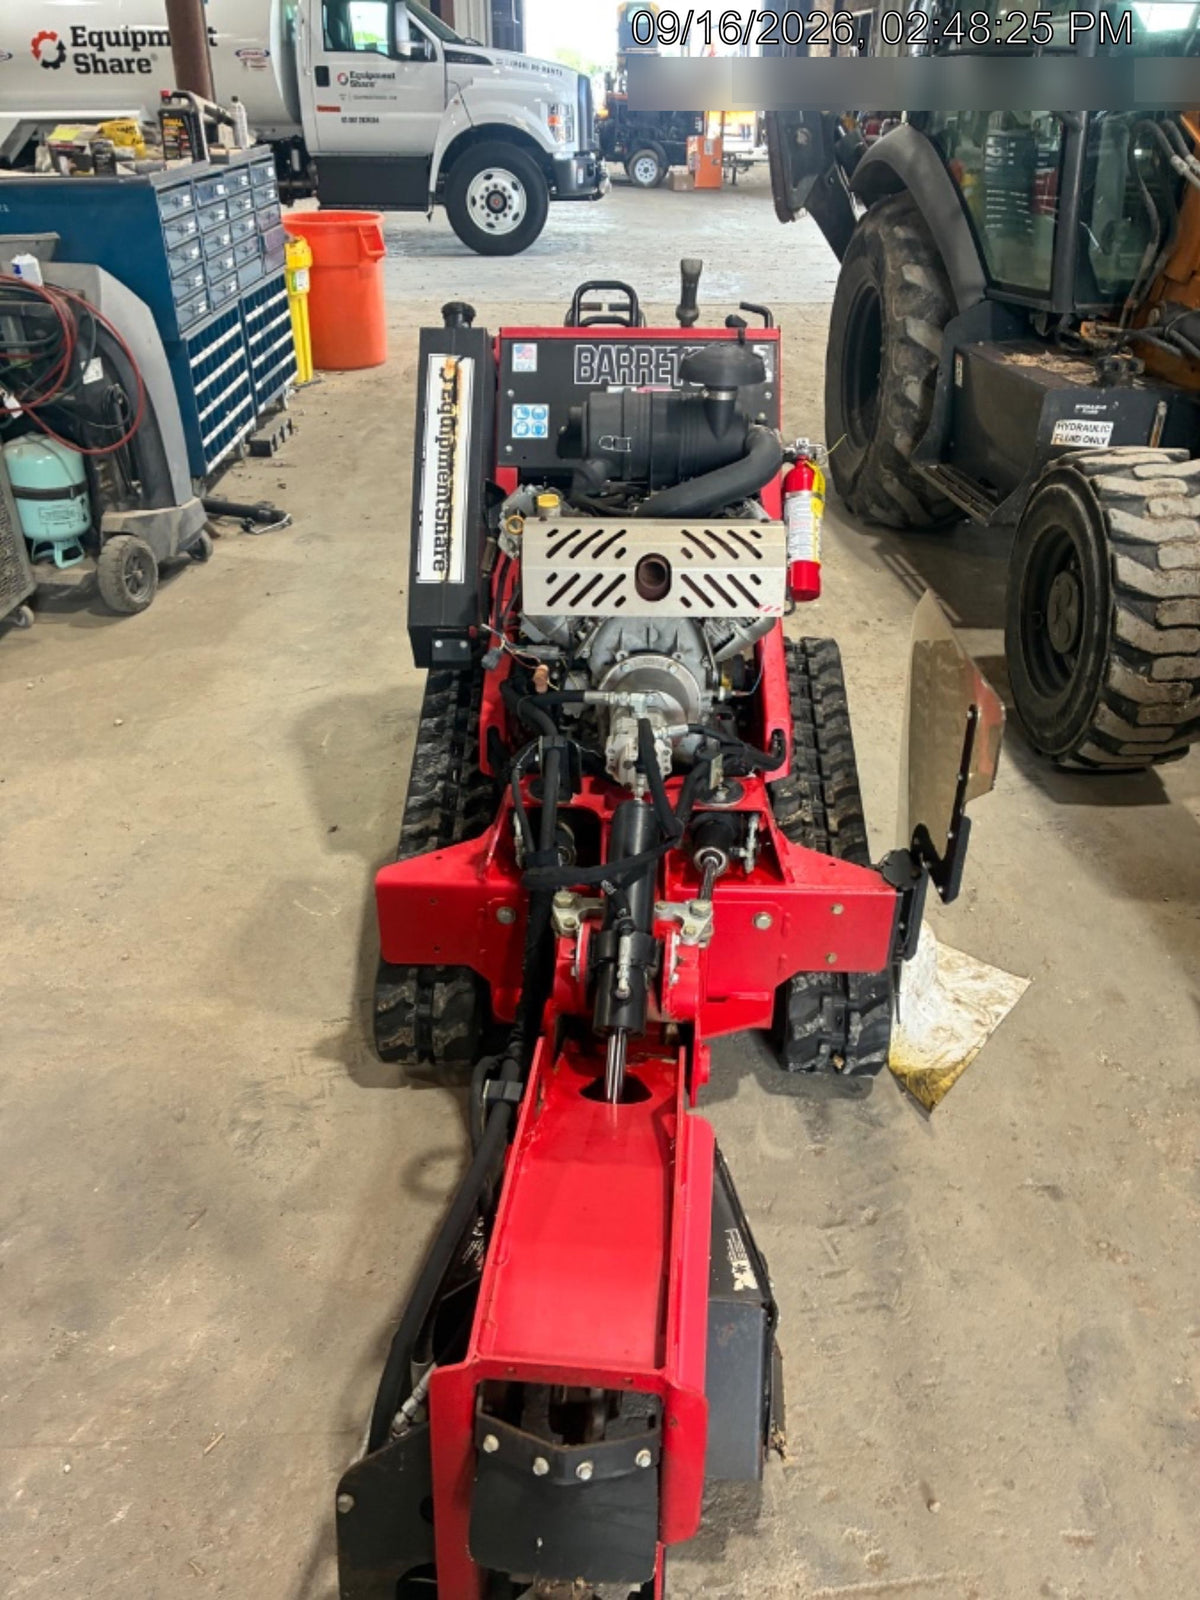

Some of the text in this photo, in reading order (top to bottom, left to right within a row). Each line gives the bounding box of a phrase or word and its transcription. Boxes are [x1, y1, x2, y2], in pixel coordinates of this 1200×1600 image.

[69, 26, 218, 51] Equipmt
[73, 53, 152, 74] Share
[349, 71, 395, 80] Equipment
[1057, 422, 1111, 433] HYDRAULIC
[1054, 433, 1108, 445] FLUID ONLY
